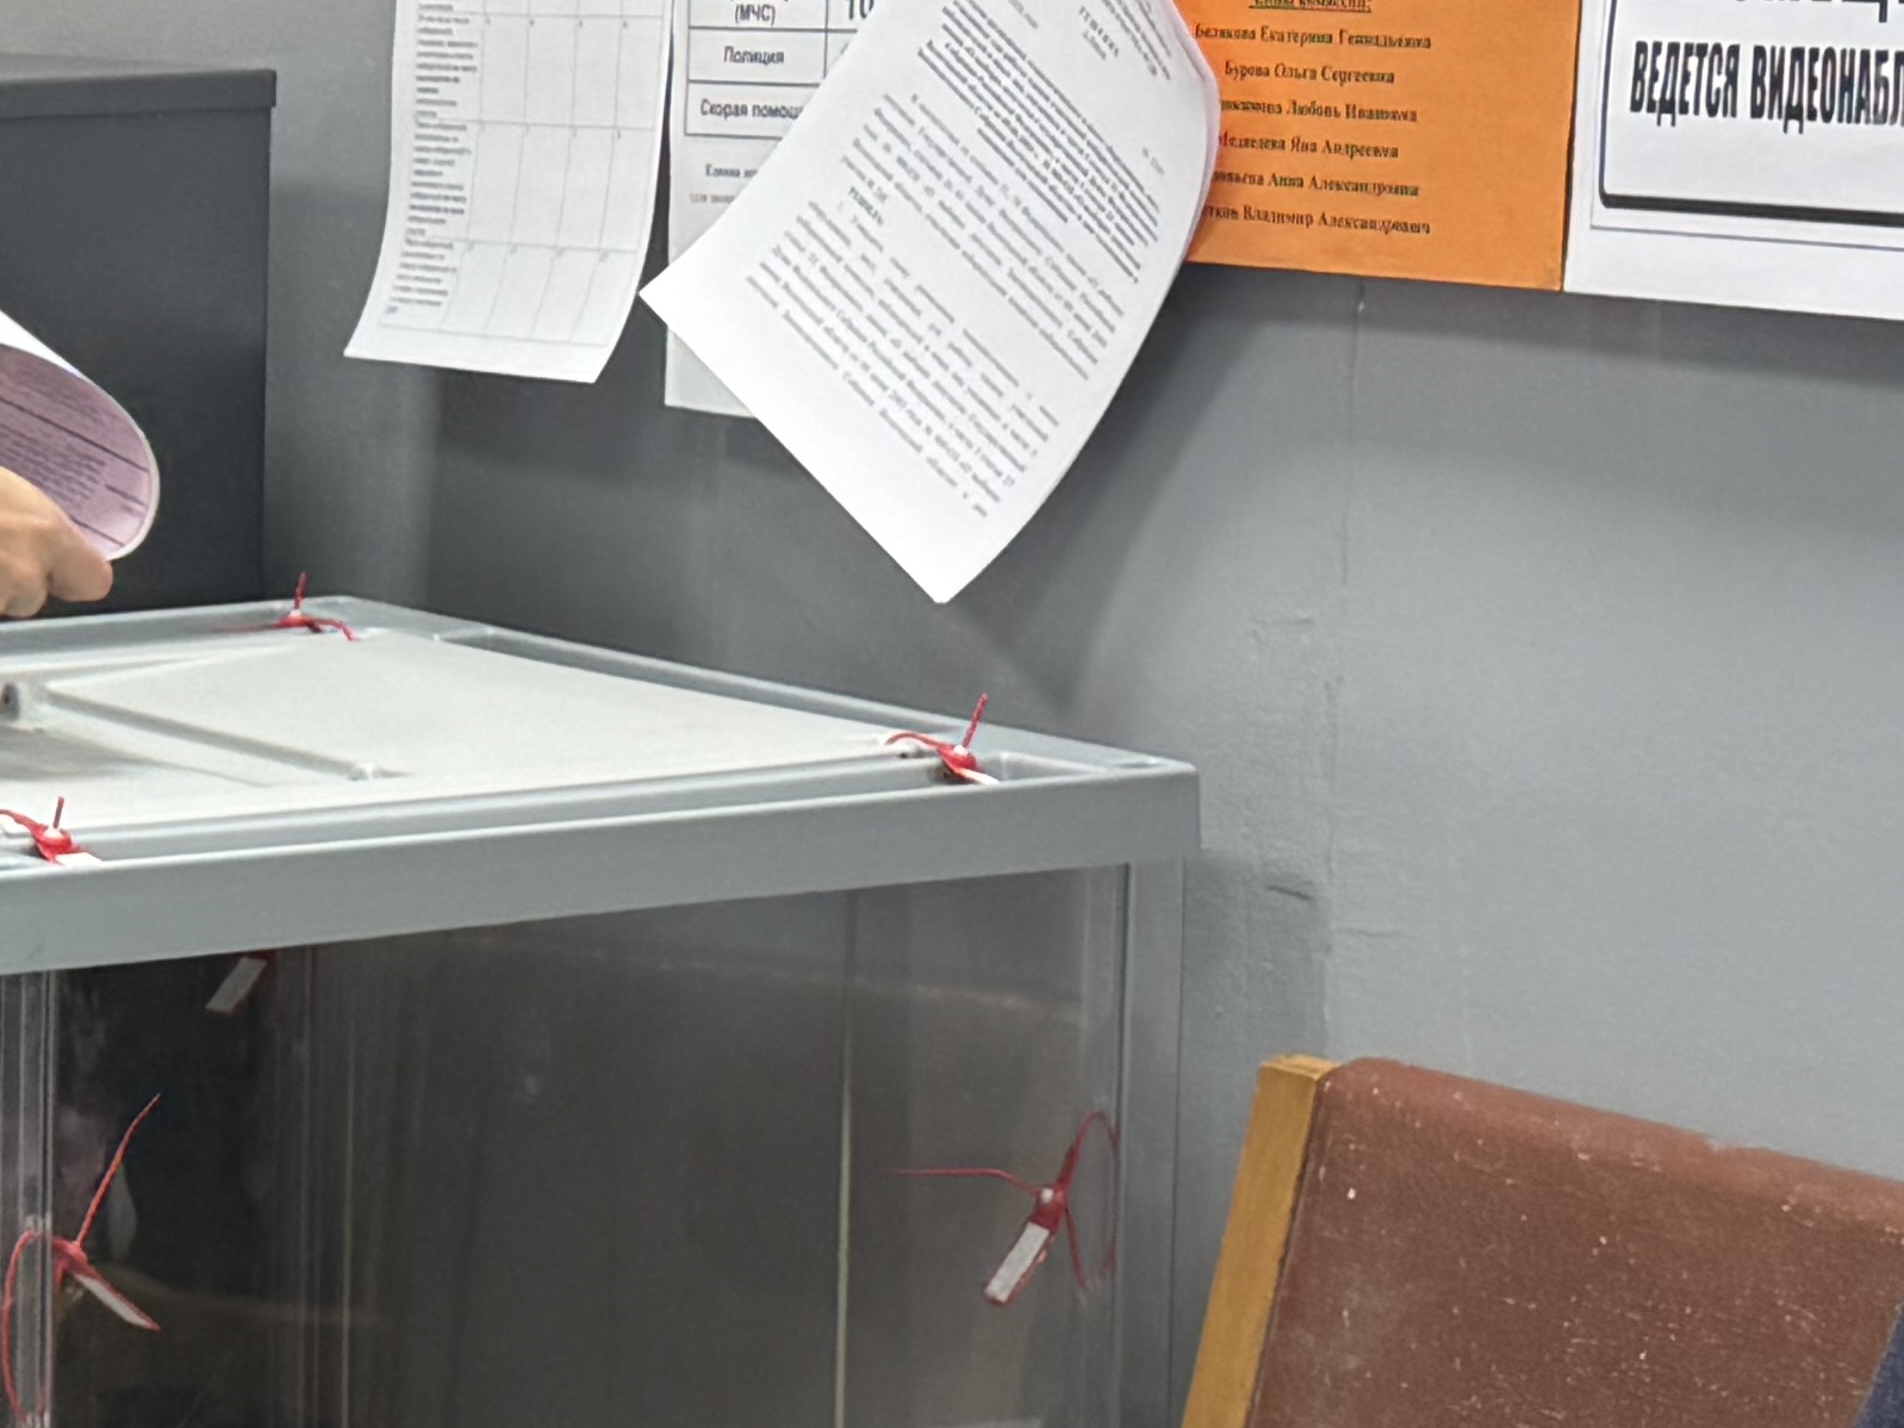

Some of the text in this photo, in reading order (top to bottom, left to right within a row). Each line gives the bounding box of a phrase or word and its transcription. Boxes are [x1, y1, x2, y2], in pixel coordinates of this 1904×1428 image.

[734, 4, 775, 25] (МЧС)
[1261, 26, 1333, 46] Екатерина
[1339, 29, 1431, 48] Геннадьевна
[724, 46, 784, 65] Полиция
[1225, 61, 1395, 85] Бурова Ольга Сергеевна
[1630, 40, 1904, 134] ВЕДЕТСЯ ВИДЕОНАБЛ
[701, 99, 748, 119] Скорая
[1286, 99, 1340, 118] Любовь
[1345, 104, 1417, 122] Ивановна
[1291, 136, 1317, 152] Яна
[1322, 140, 1399, 159] Андреевна
[1268, 173, 1304, 187] Анна
[1310, 175, 1419, 197] Александровна
[1244, 206, 1313, 227] Владимир
[1319, 212, 1430, 234] Александрович
